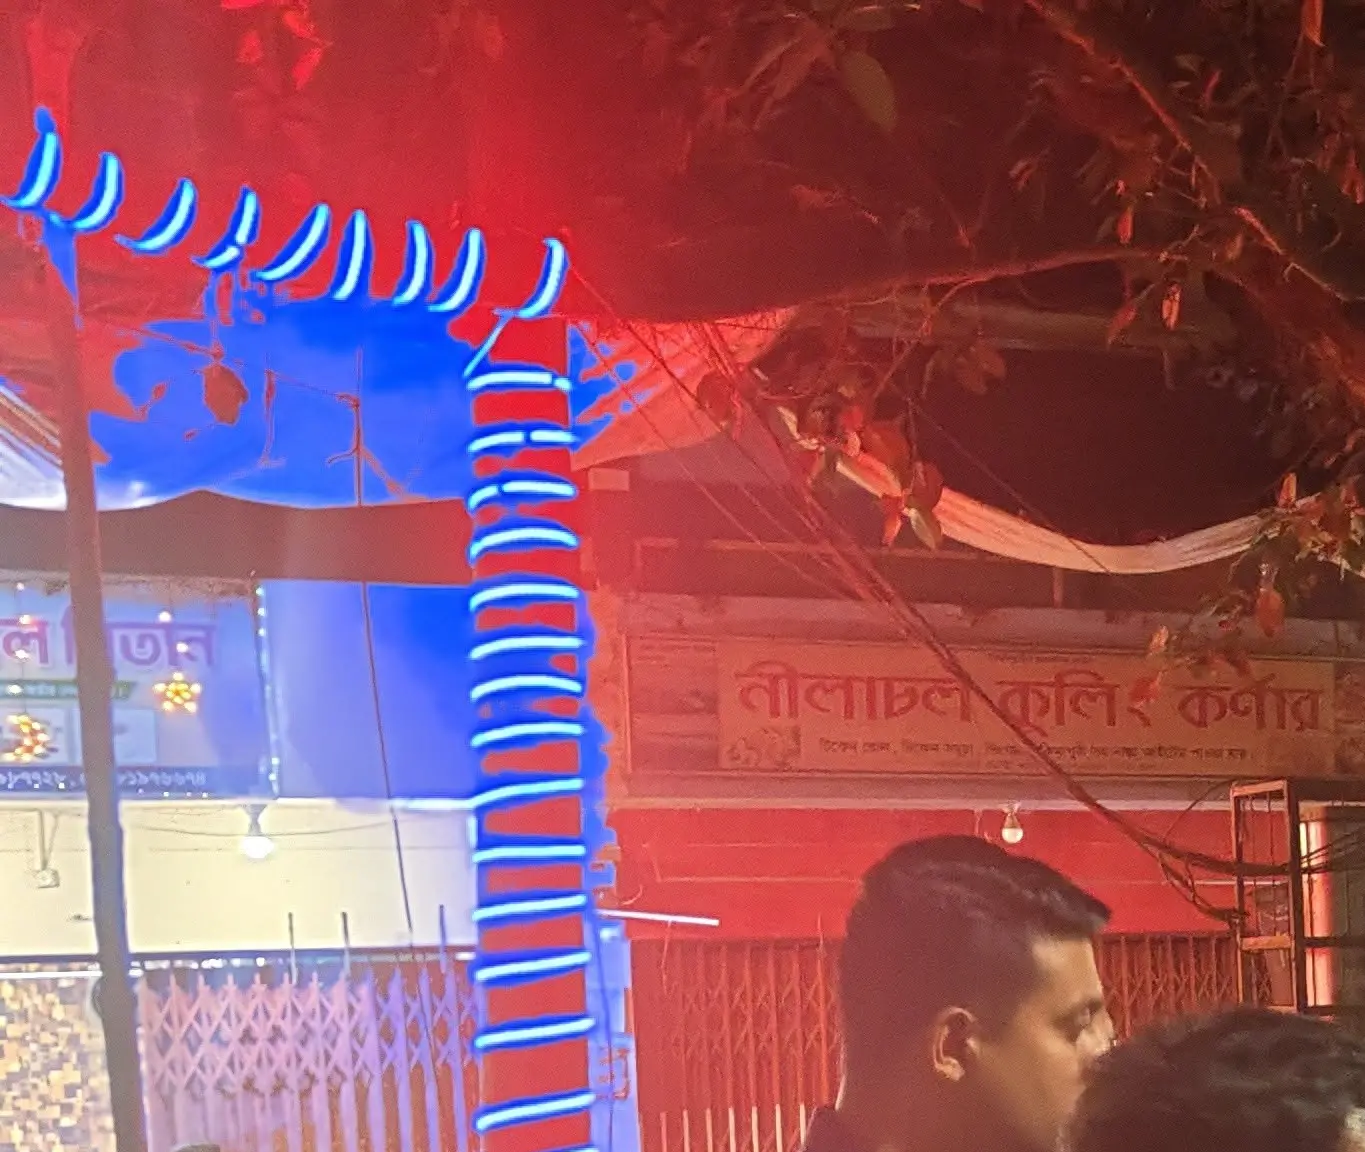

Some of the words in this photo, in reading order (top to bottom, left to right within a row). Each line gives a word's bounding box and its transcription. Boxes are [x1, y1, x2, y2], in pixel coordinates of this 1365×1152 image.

[60, 603, 218, 667] িতান
[735, 660, 972, 722] নীলাচল
[1170, 673, 1325, 732] কর্ণার
